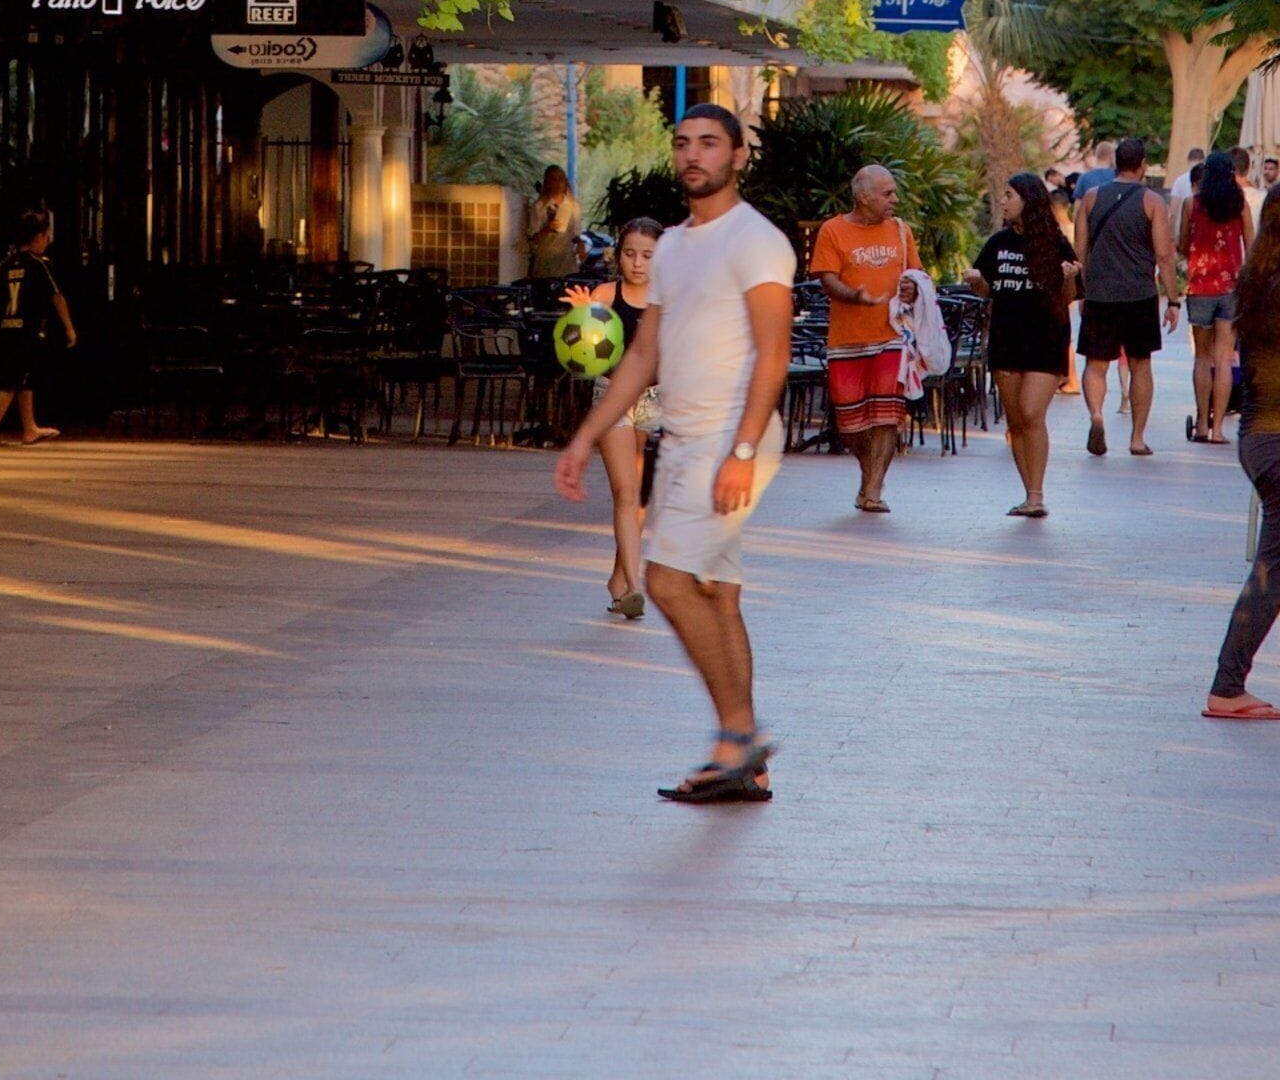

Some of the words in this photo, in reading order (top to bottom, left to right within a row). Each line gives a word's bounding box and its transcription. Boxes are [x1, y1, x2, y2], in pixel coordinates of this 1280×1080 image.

[250, 7, 294, 21] REEF
[423, 76, 444, 85] PUB
[998, 263, 1030, 275] direc
[1003, 279, 1023, 291] my
